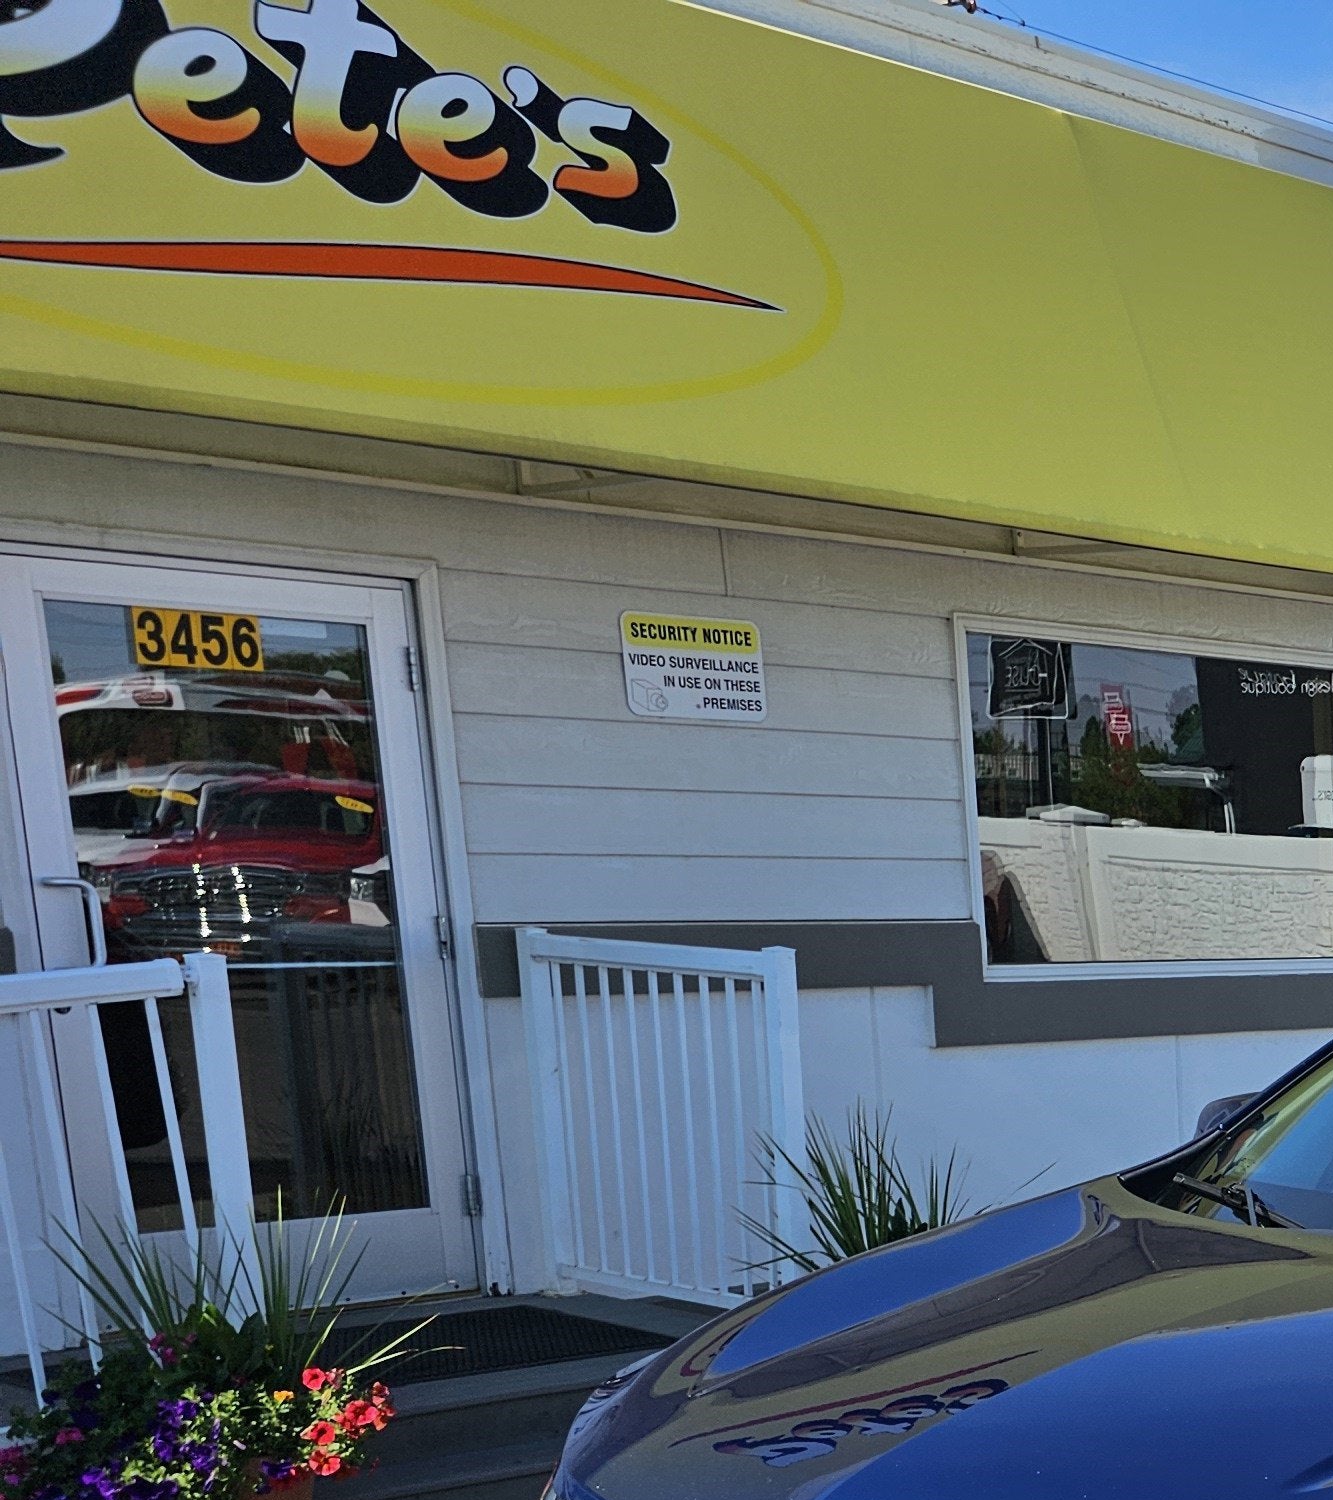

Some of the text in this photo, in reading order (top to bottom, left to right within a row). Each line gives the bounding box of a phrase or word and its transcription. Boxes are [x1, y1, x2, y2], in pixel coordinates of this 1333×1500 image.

[0, 0, 672, 228] ete's
[137, 610, 260, 668] 3456
[630, 622, 752, 647] SECURITY NOTICE
[628, 653, 759, 674] VIDEO SURVEILLANCE
[664, 675, 761, 693] IN USE ON THESE
[703, 697, 762, 712] PREMISES
